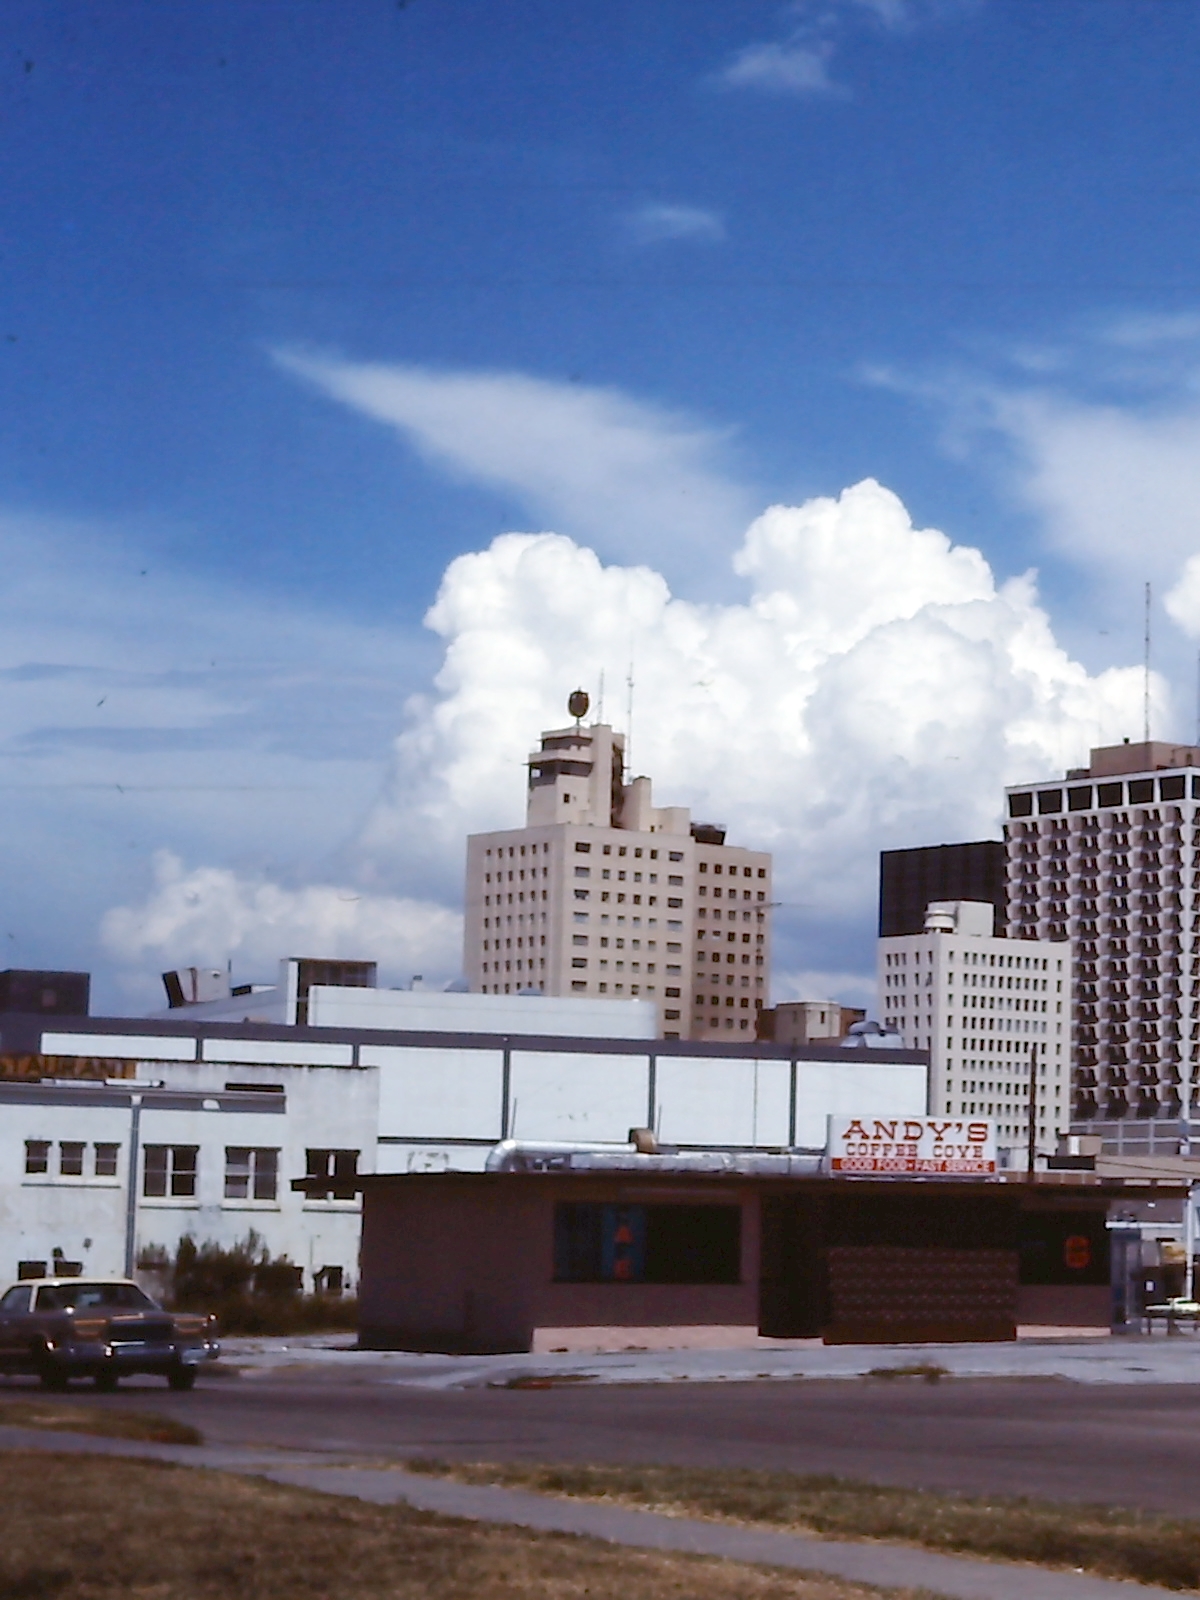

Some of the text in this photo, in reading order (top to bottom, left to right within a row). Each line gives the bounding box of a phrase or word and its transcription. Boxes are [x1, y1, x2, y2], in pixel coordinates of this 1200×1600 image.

[842, 1119, 989, 1143] ANDY'S
[845, 1142, 984, 1159] COFFEE COVE
[840, 1158, 991, 1173] GOOD FOOD FAST SERVICE
